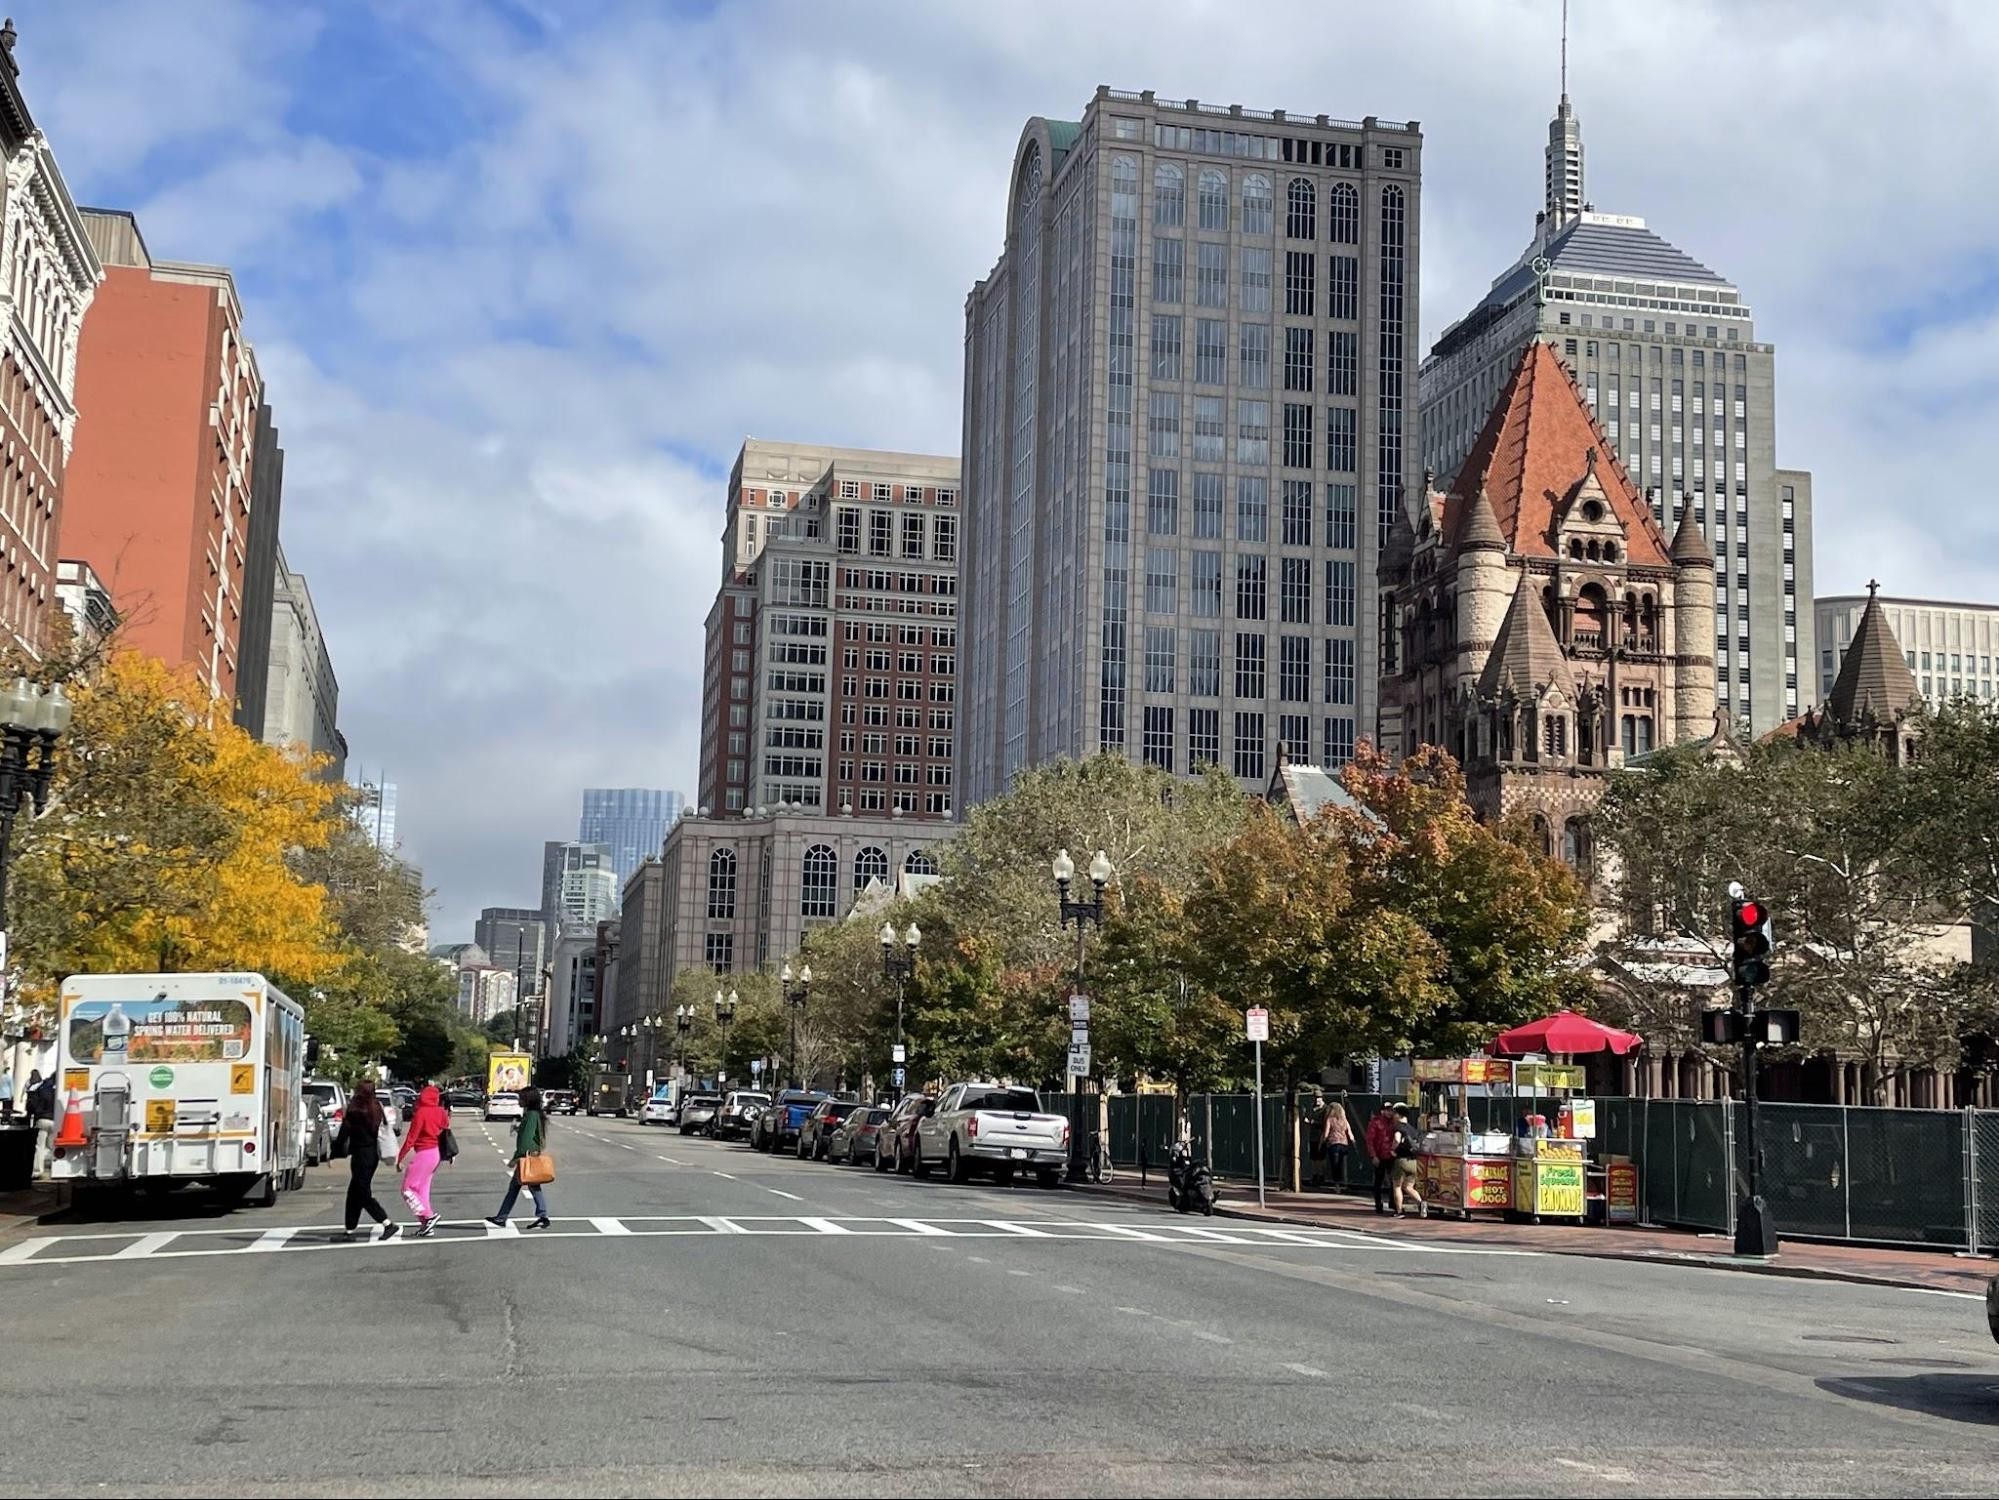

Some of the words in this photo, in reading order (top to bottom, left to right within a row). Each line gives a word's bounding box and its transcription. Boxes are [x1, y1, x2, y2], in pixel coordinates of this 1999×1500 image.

[148, 1012, 162, 1023] GET
[164, 1012, 185, 1023] 100%
[186, 1011, 222, 1023] NATURAL
[134, 1025, 163, 1036] SPRING
[164, 1025, 192, 1036] WATER
[193, 1024, 234, 1036] DELIVERED
[1070, 1065, 1086, 1073] ONLY
[1546, 1166, 1576, 1178] Fresh
[1484, 1186, 1504, 1194] HOT
[1480, 1193, 1508, 1204] DOGS
[1540, 1188, 1581, 1213] LEMONADE
